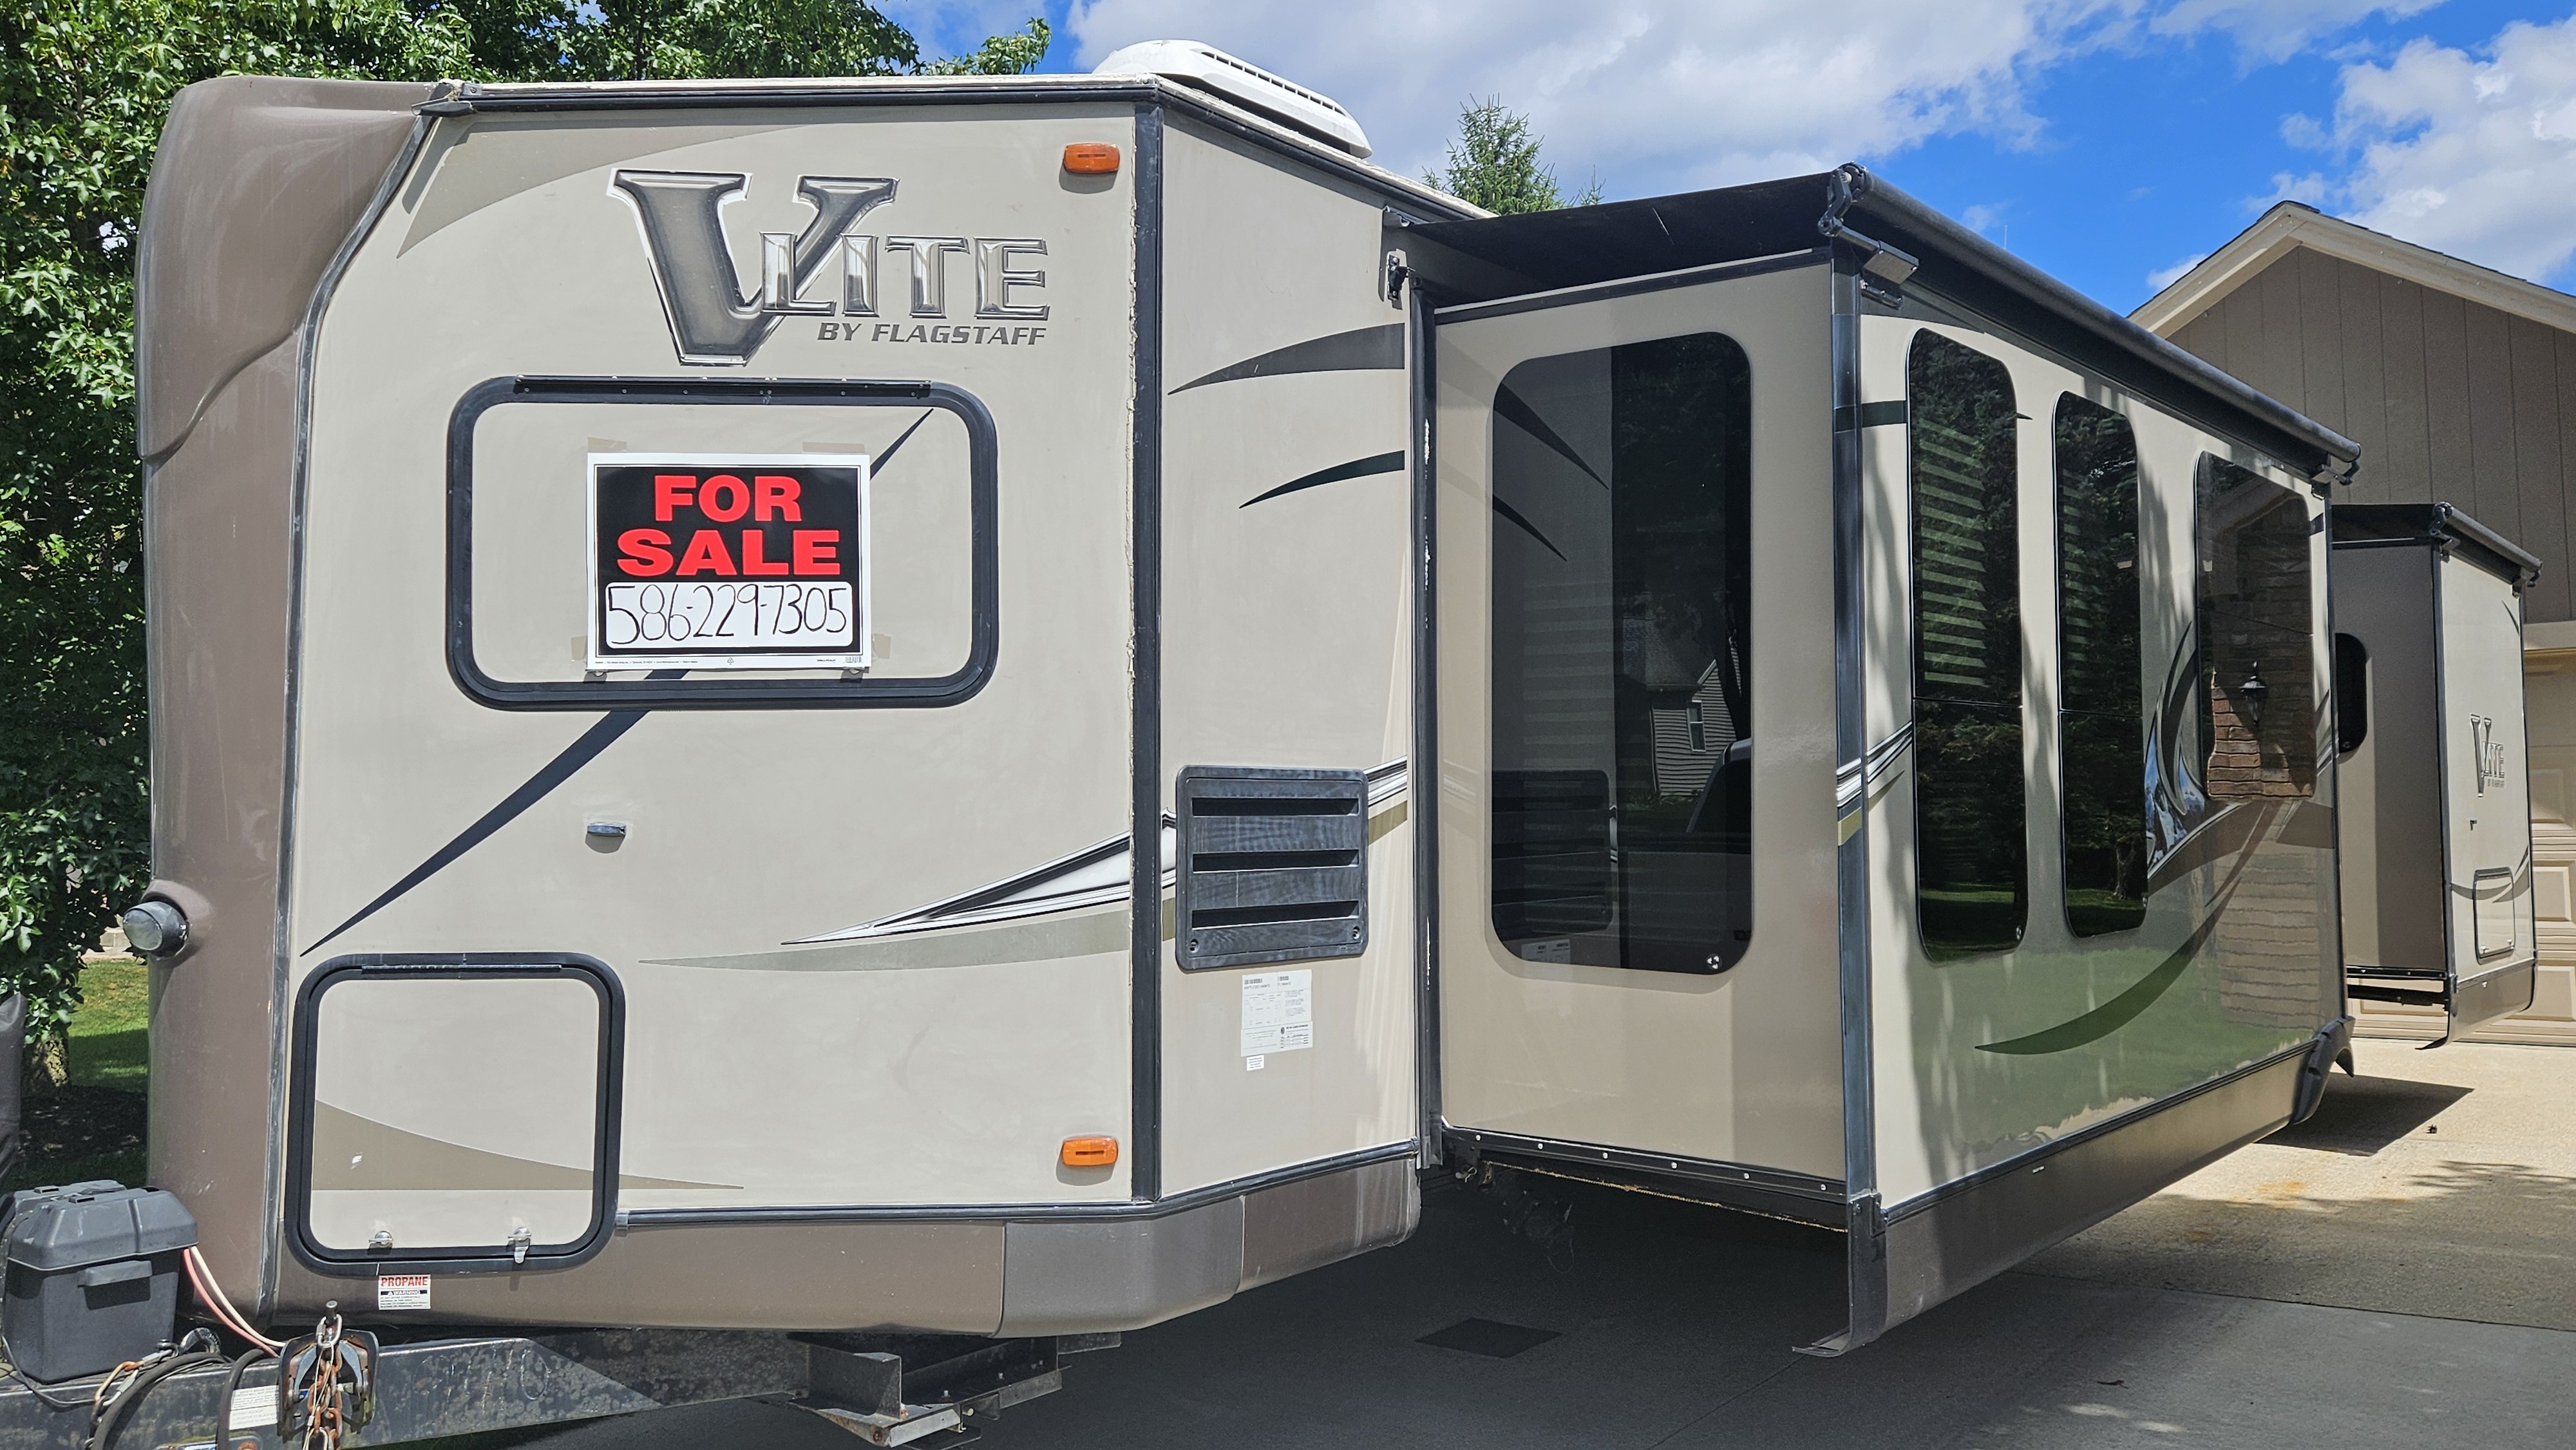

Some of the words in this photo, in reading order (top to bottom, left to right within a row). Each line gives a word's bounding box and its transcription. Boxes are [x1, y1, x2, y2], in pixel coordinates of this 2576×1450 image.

[817, 322, 862, 341] BY
[871, 323, 1047, 346] FLAGSTAFF
[654, 475, 802, 522] FOR
[617, 528, 840, 576] SALE
[608, 583, 847, 645] 586-229-7305
[381, 1276, 428, 1286] PROPANE
